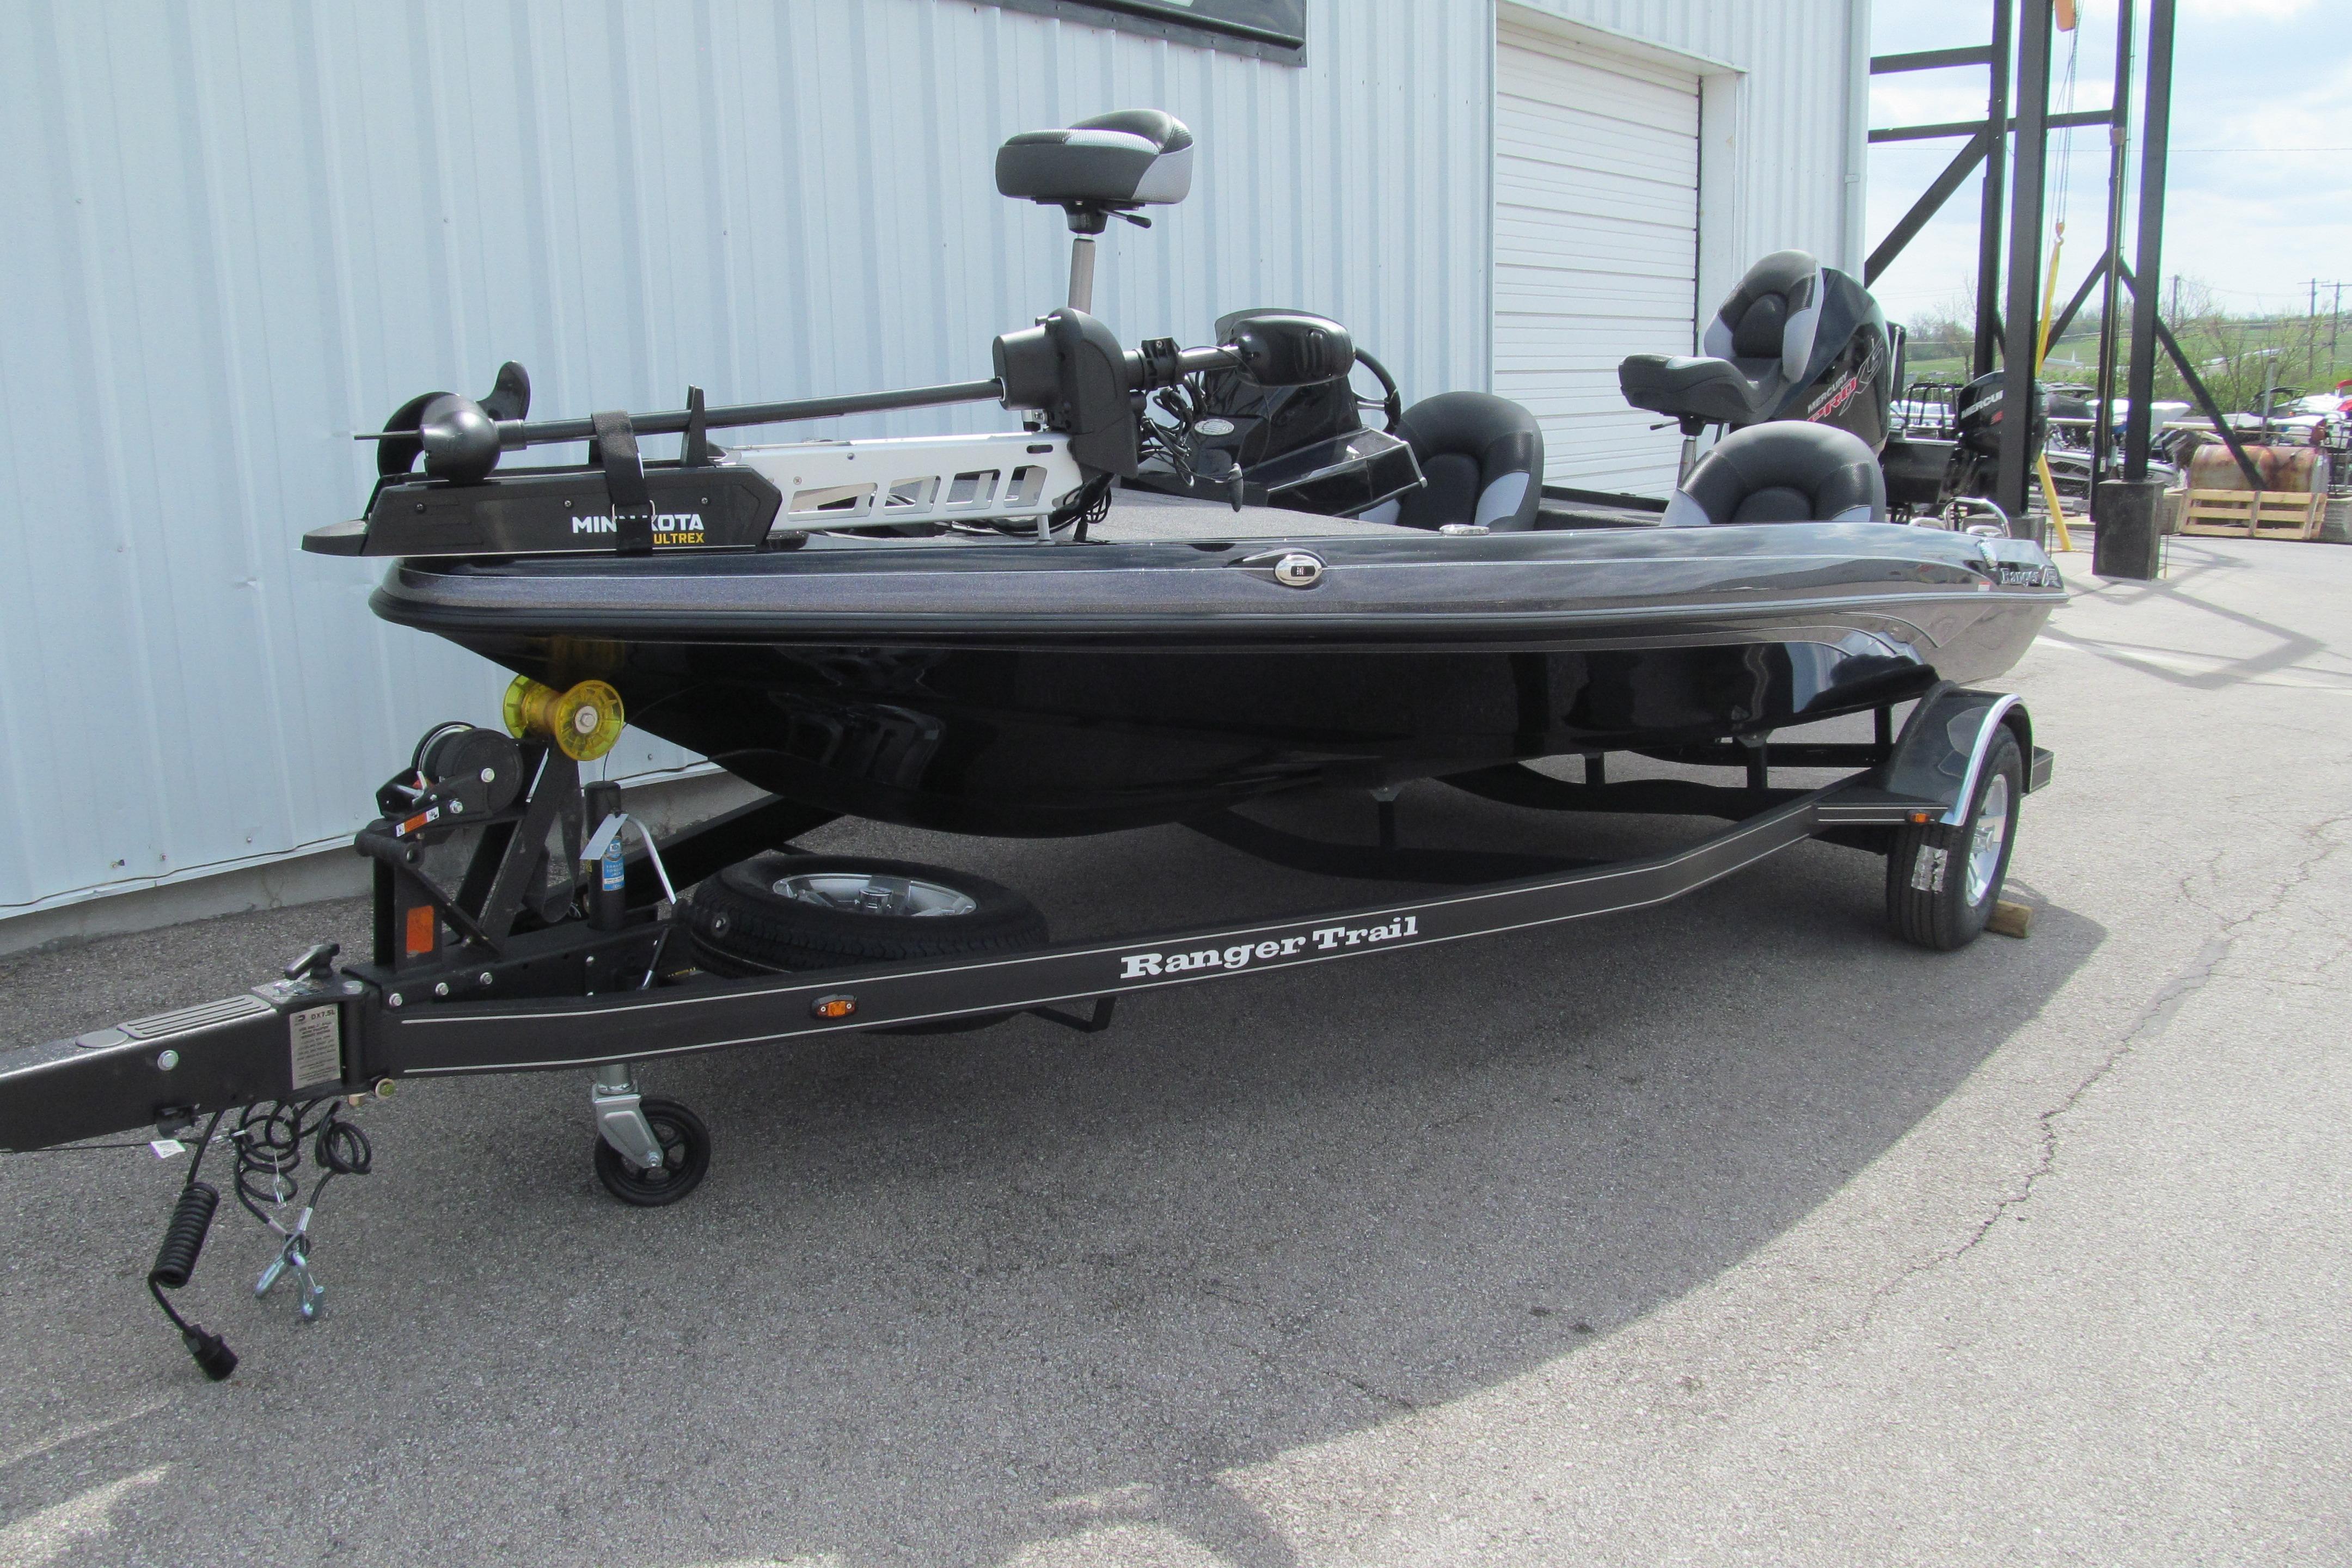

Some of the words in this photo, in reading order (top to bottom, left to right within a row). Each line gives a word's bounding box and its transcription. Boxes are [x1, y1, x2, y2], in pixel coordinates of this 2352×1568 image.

[1808, 370, 1848, 414] MERCURY
[654, 532, 705, 544] ULTREX
[1120, 936, 1306, 978] Ranger
[1313, 916, 1418, 950] Trail
